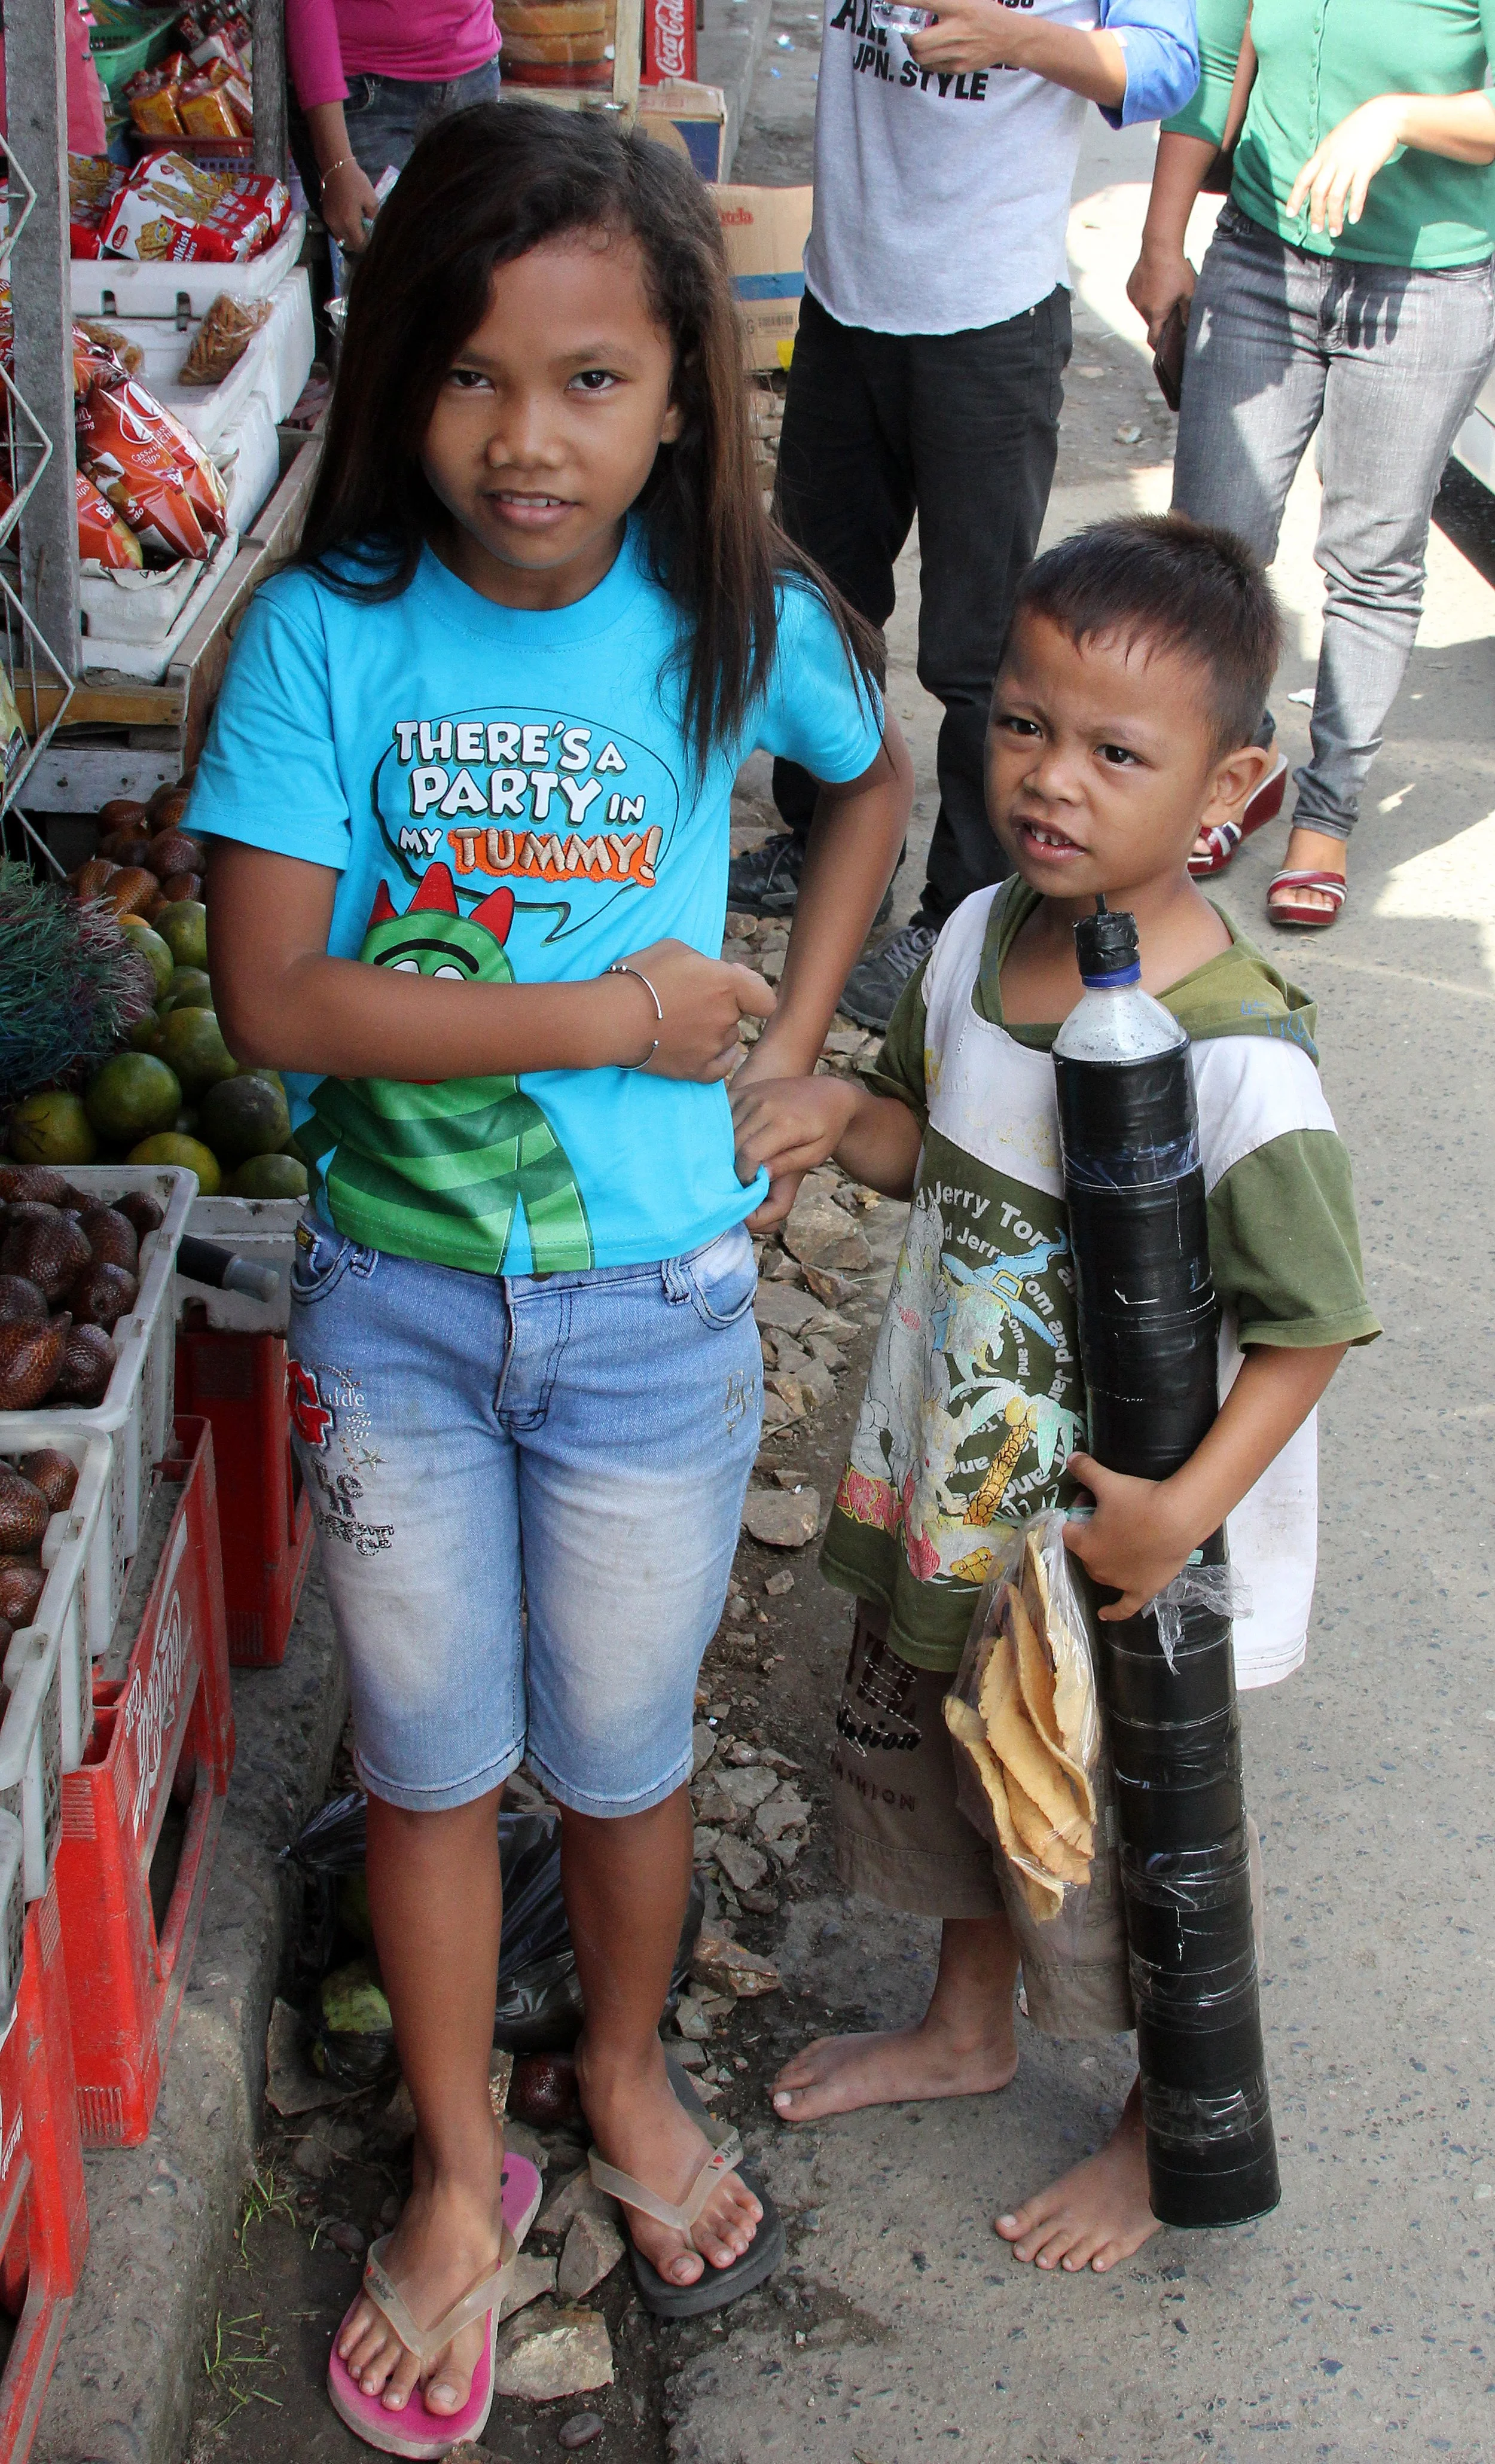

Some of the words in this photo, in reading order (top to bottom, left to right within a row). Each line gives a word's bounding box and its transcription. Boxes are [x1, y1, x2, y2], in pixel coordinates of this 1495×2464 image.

[853, 42, 895, 82] JPN.
[899, 60, 988, 101] STYLE
[173, 230, 191, 262] alkist
[141, 453, 161, 467] Chips
[76, 483, 90, 500] hips
[393, 719, 592, 775] THERE'S
[594, 741, 627, 775] A
[409, 765, 603, 826] PARTY
[605, 793, 646, 824] IN
[398, 827, 443, 857] MY
[453, 826, 664, 880] TUMMY!
[930, 1180, 991, 1219] Jerry
[956, 1227, 1007, 1259] Jerr
[1017, 1348, 1030, 1376] and
